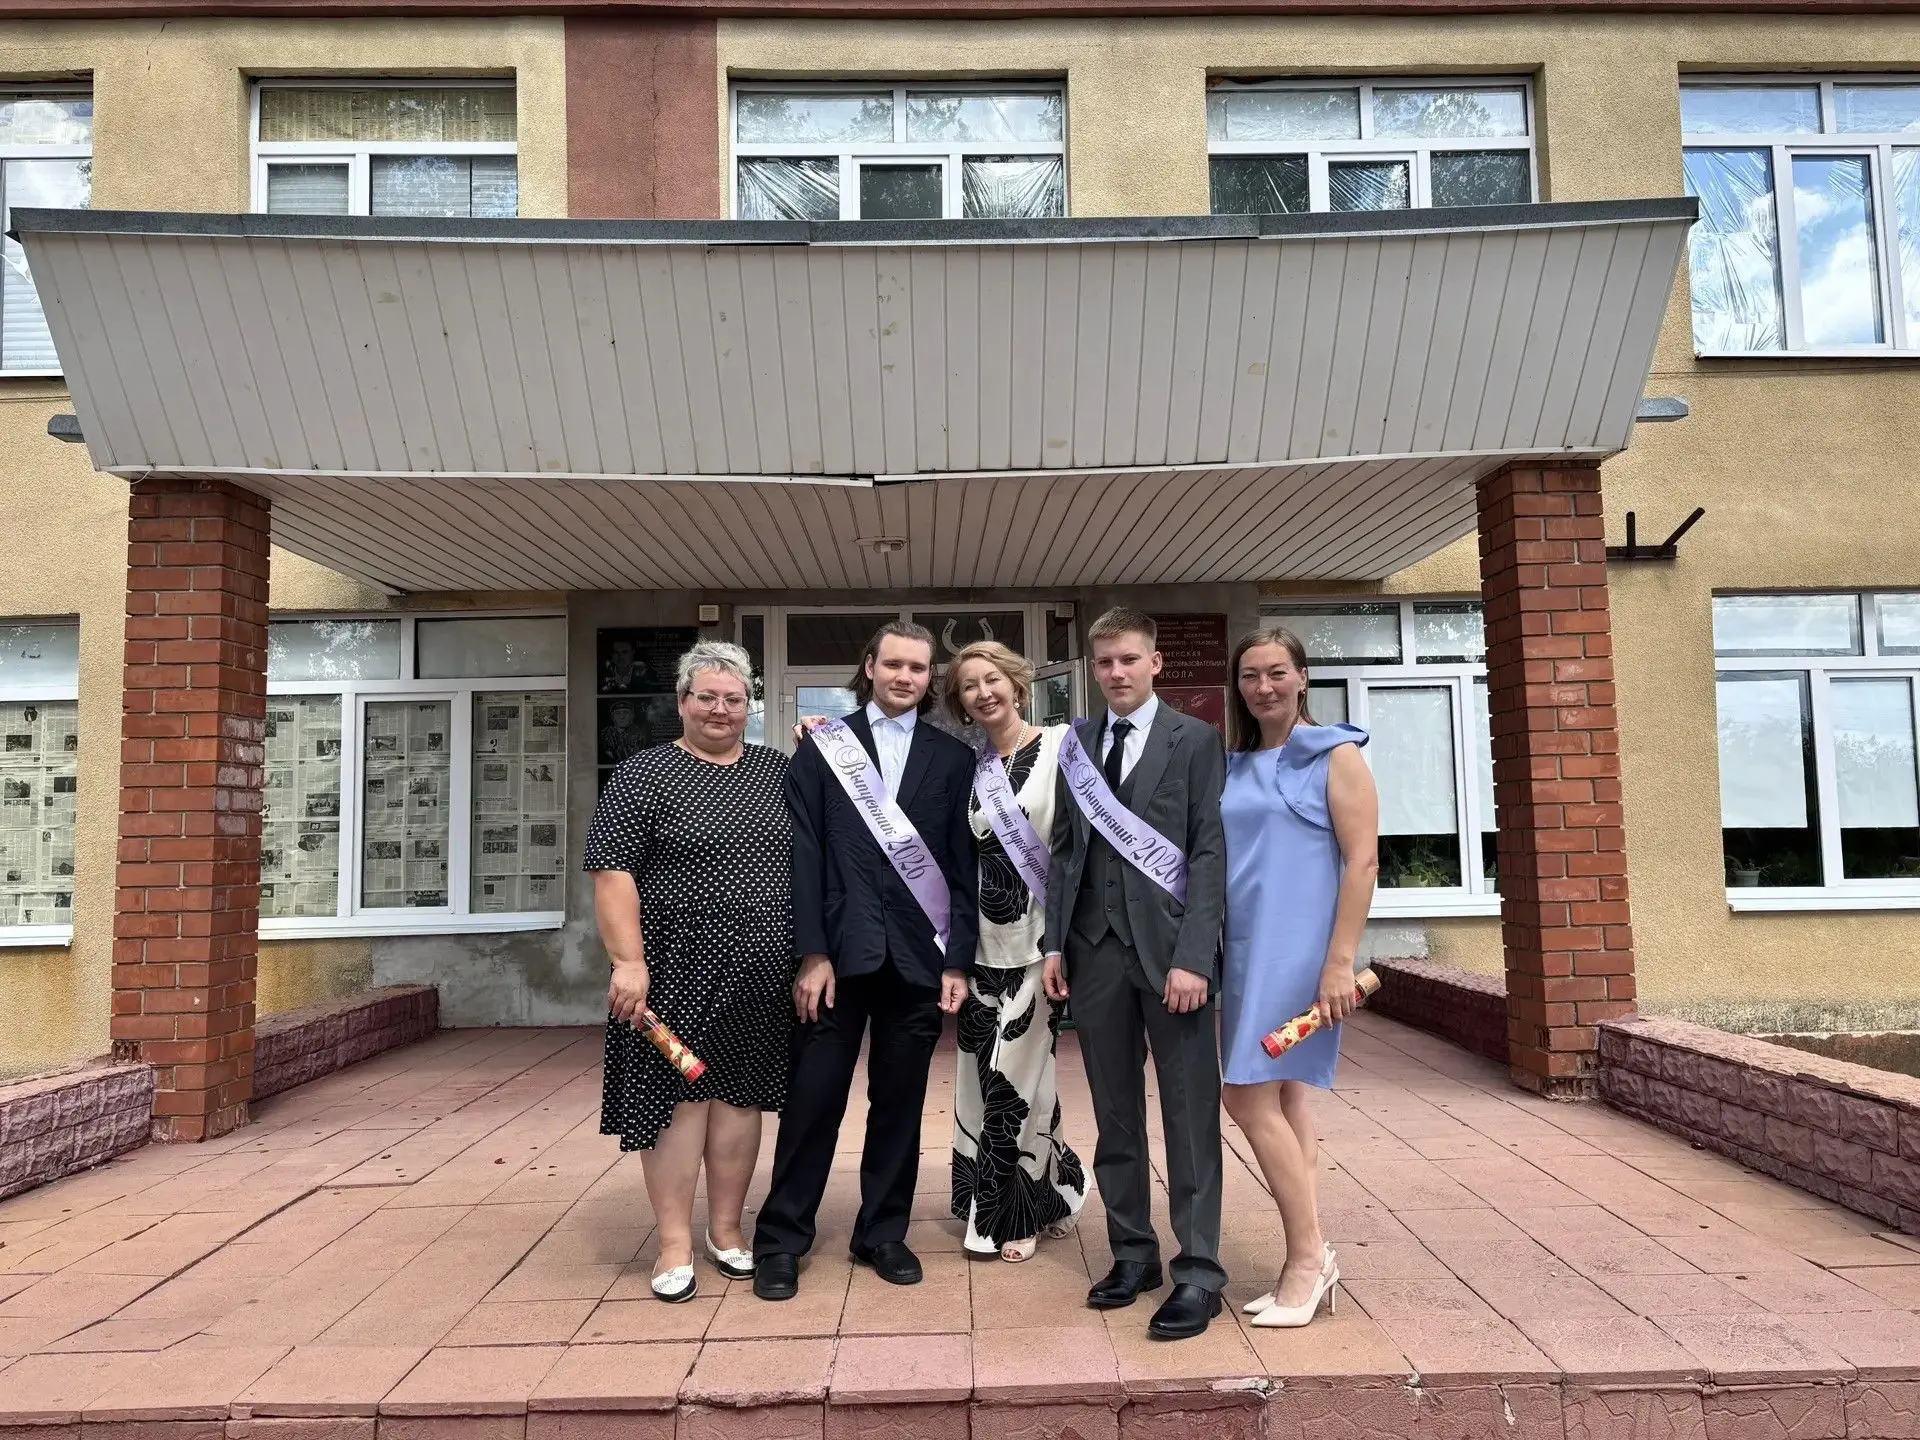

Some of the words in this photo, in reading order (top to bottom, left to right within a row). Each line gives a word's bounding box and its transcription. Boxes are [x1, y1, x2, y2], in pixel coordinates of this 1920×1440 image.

[1158, 670, 1194, 680] ШКОЛА
[835, 745, 897, 837] Выпускник
[885, 834, 934, 880] 2026
[1072, 762, 1138, 847] Выпускник
[1130, 837, 1188, 884] 2026
[1001, 828, 1050, 890] руководител
